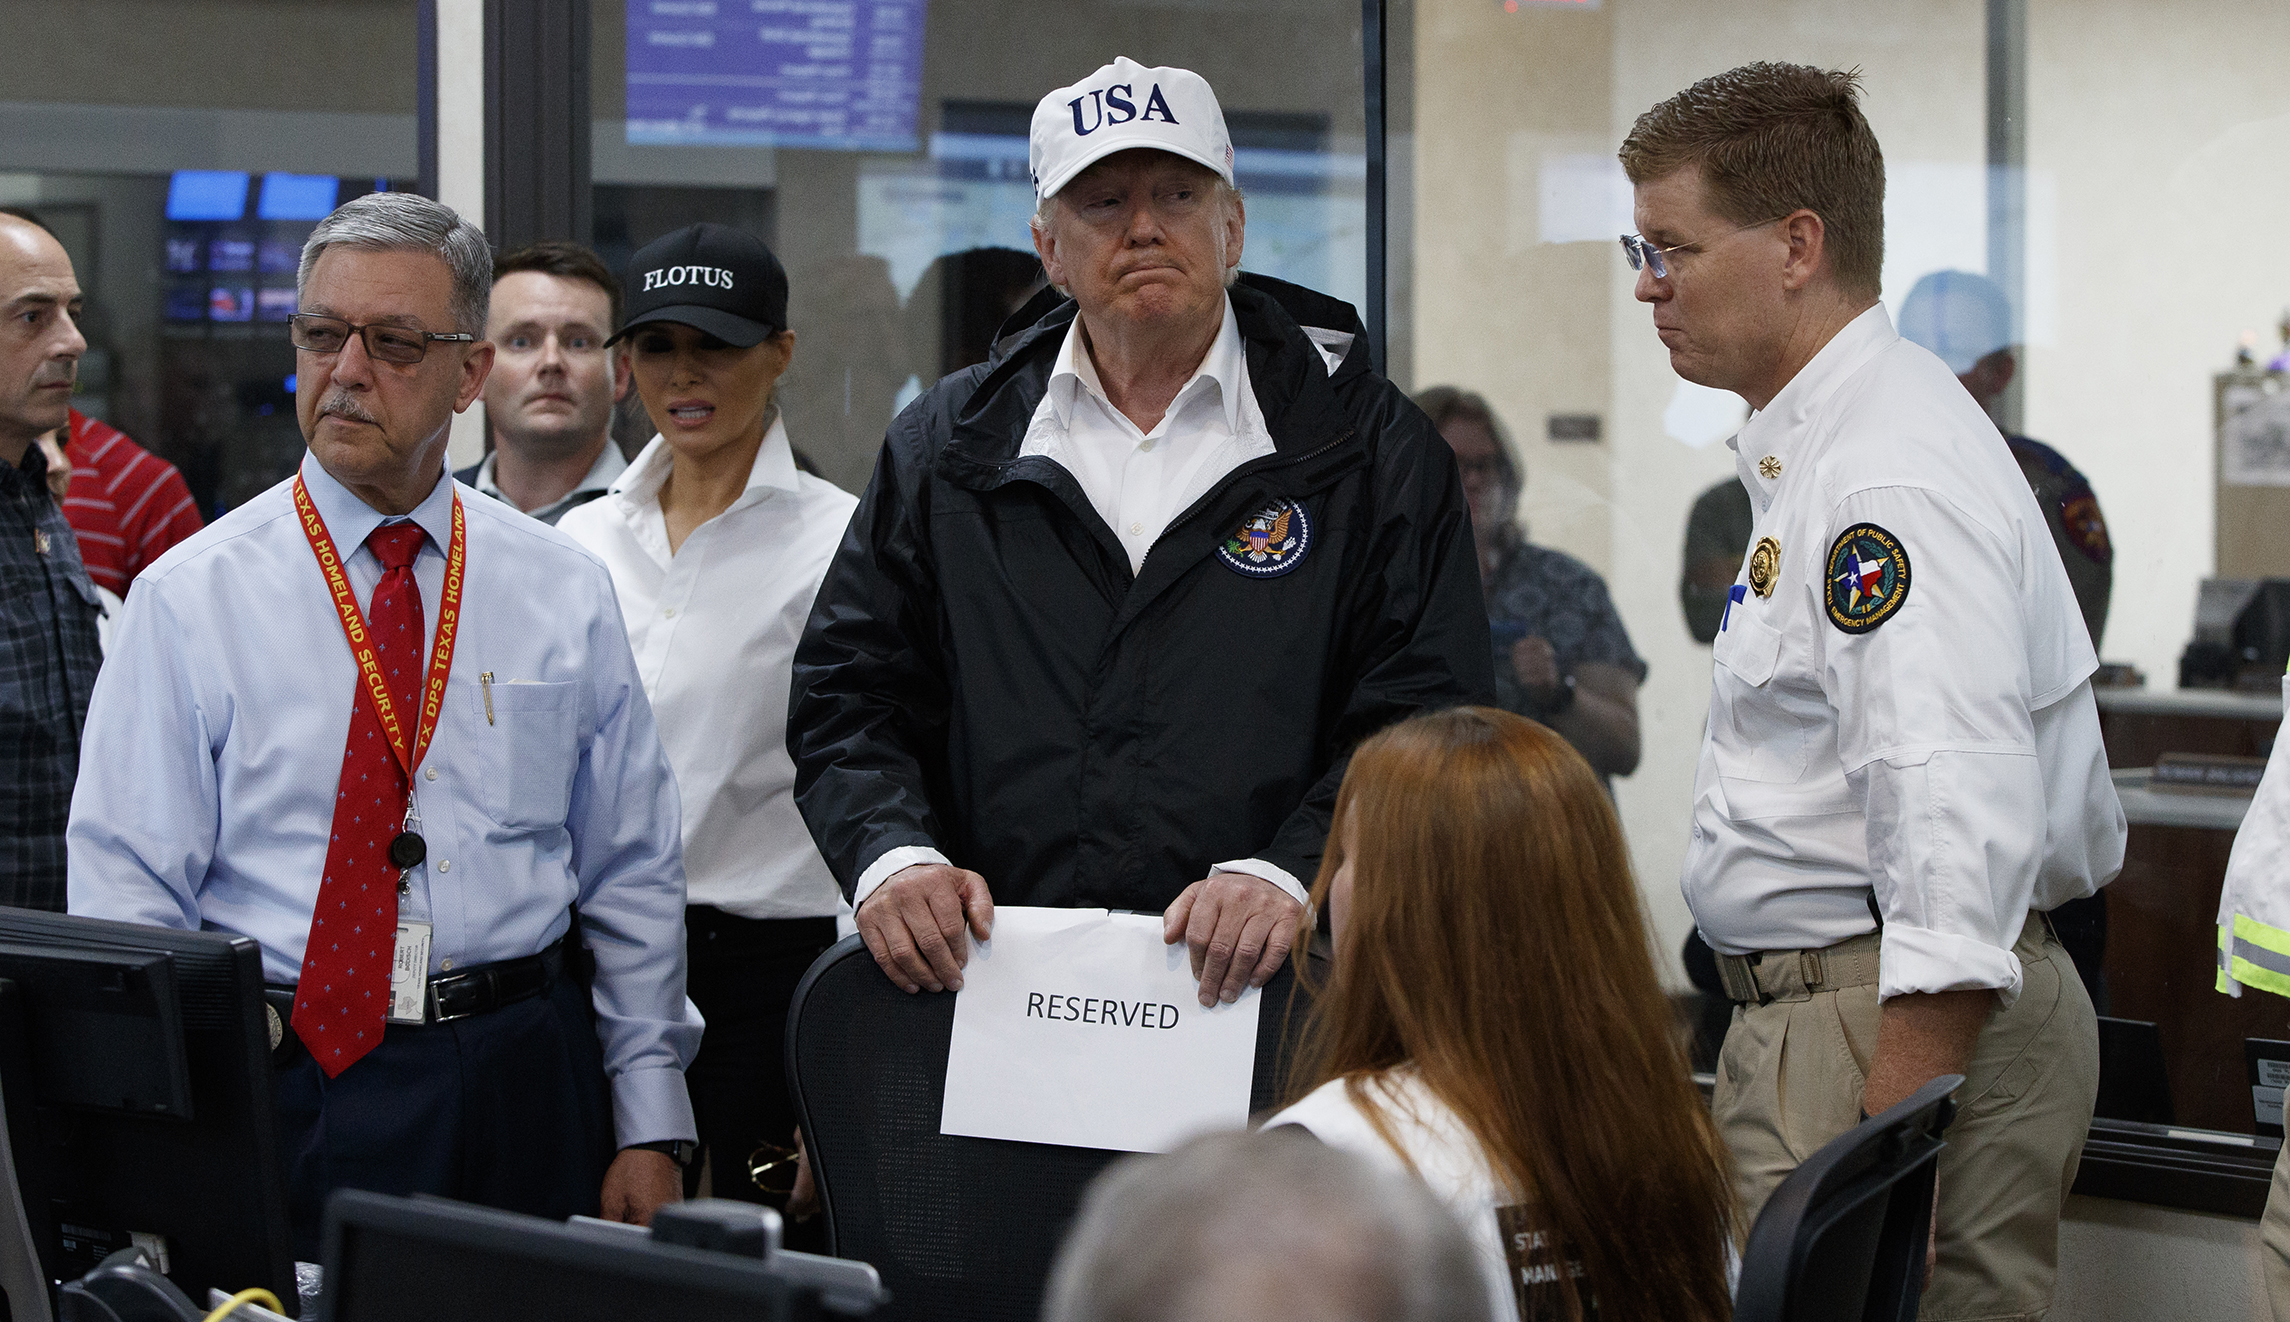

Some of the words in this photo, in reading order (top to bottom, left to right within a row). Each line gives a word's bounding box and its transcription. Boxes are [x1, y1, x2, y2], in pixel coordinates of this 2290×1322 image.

[1067, 83, 1180, 136] USA
[643, 266, 734, 292] FLOTUS
[445, 505, 463, 604] HOMELAND
[1828, 531, 1855, 575] DEPARTMENT
[1857, 528, 1867, 537] OF
[1867, 529, 1894, 549] PUBLIC
[1891, 548, 1907, 579] SAFETY
[296, 481, 322, 536] TEXAS
[315, 539, 365, 643] HOMELAND
[358, 648, 404, 750] SECURITY
[1830, 606, 1864, 627] EMERGENCY
[1866, 582, 1905, 625] MANAGEMENT
[434, 608, 455, 670] TEXAS
[426, 680, 443, 718] DPS
[418, 723, 433, 749] TX
[1026, 992, 1180, 1030] RESERVED
